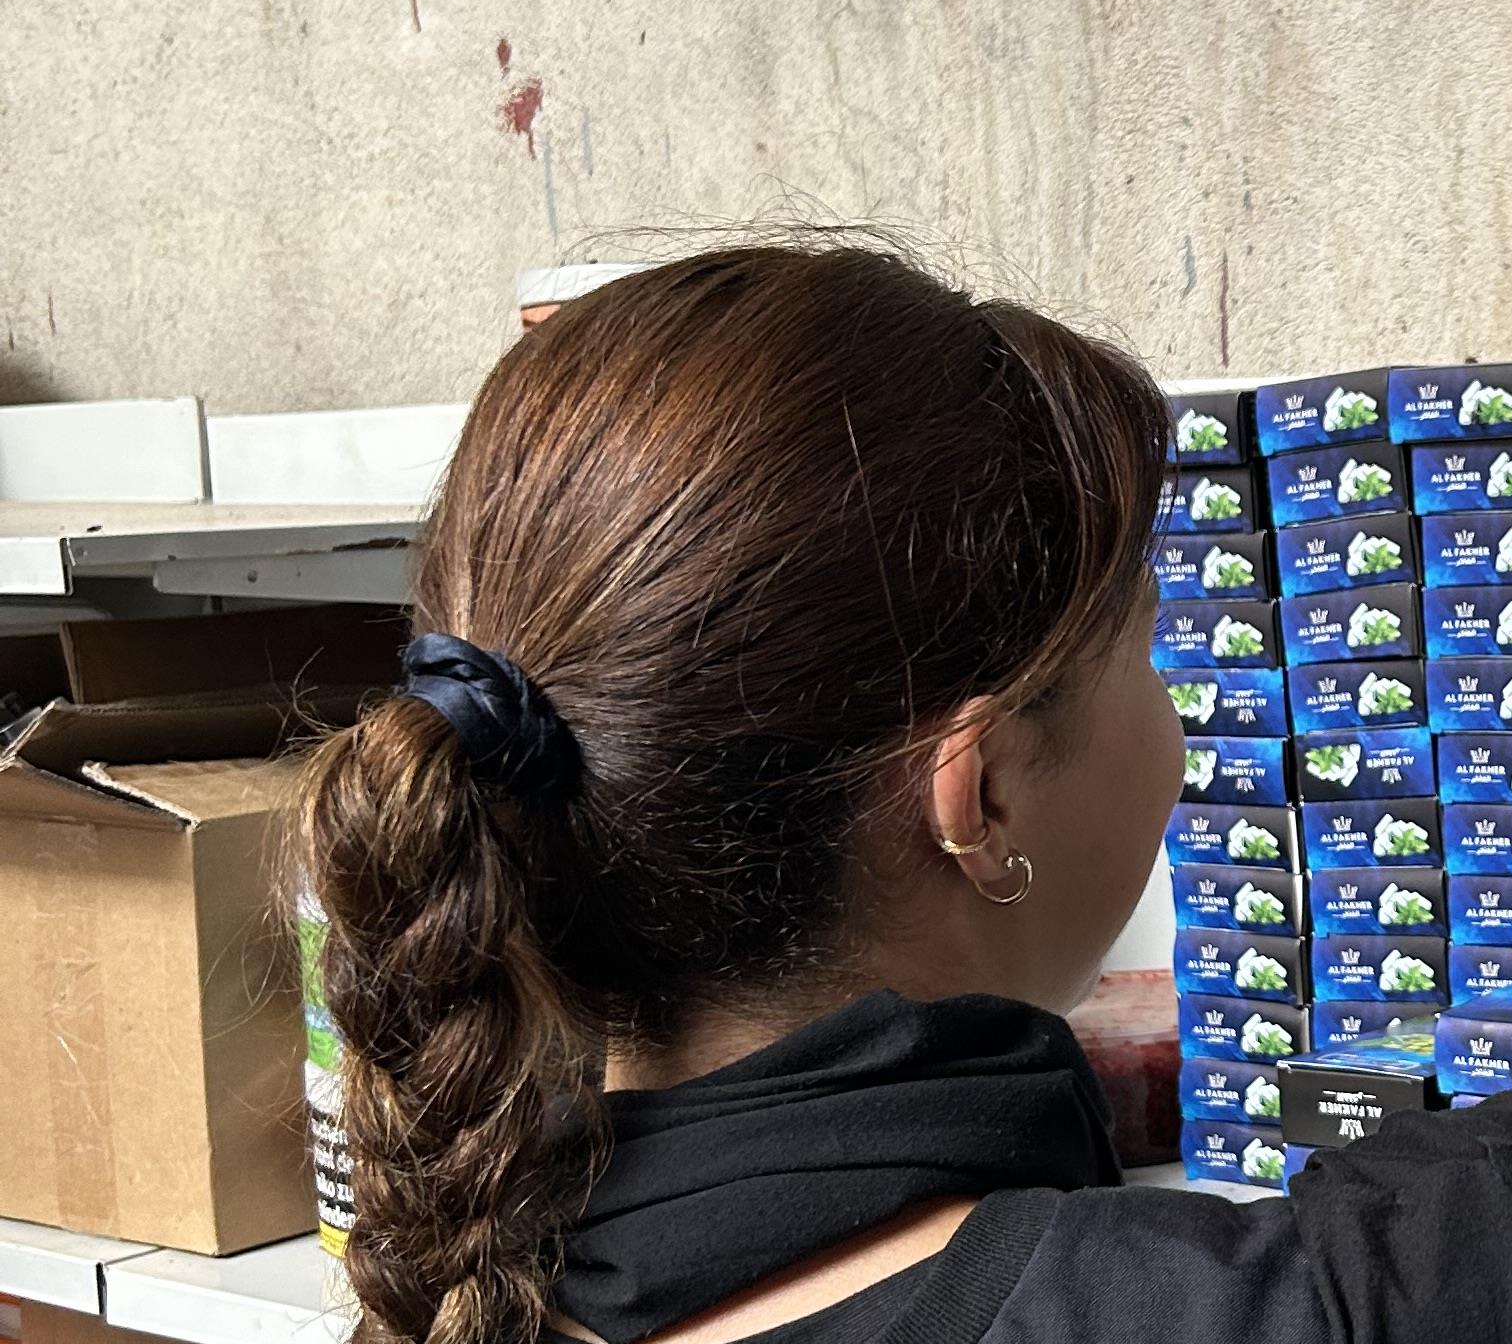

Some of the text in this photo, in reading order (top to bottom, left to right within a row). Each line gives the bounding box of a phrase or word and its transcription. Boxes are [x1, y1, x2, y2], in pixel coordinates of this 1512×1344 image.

[1404, 402, 1417, 411] AL
[1431, 474, 1443, 482] AL
[1440, 548, 1453, 557] AL
[1441, 620, 1453, 628] AL
[1444, 693, 1457, 702] AL
[1455, 765, 1468, 773] AL
[1461, 836, 1474, 845] AL
[1465, 908, 1478, 917] AL
[1453, 1056, 1509, 1070] AL FAKHER
[1318, 1101, 1382, 1118] AL FAKHER
